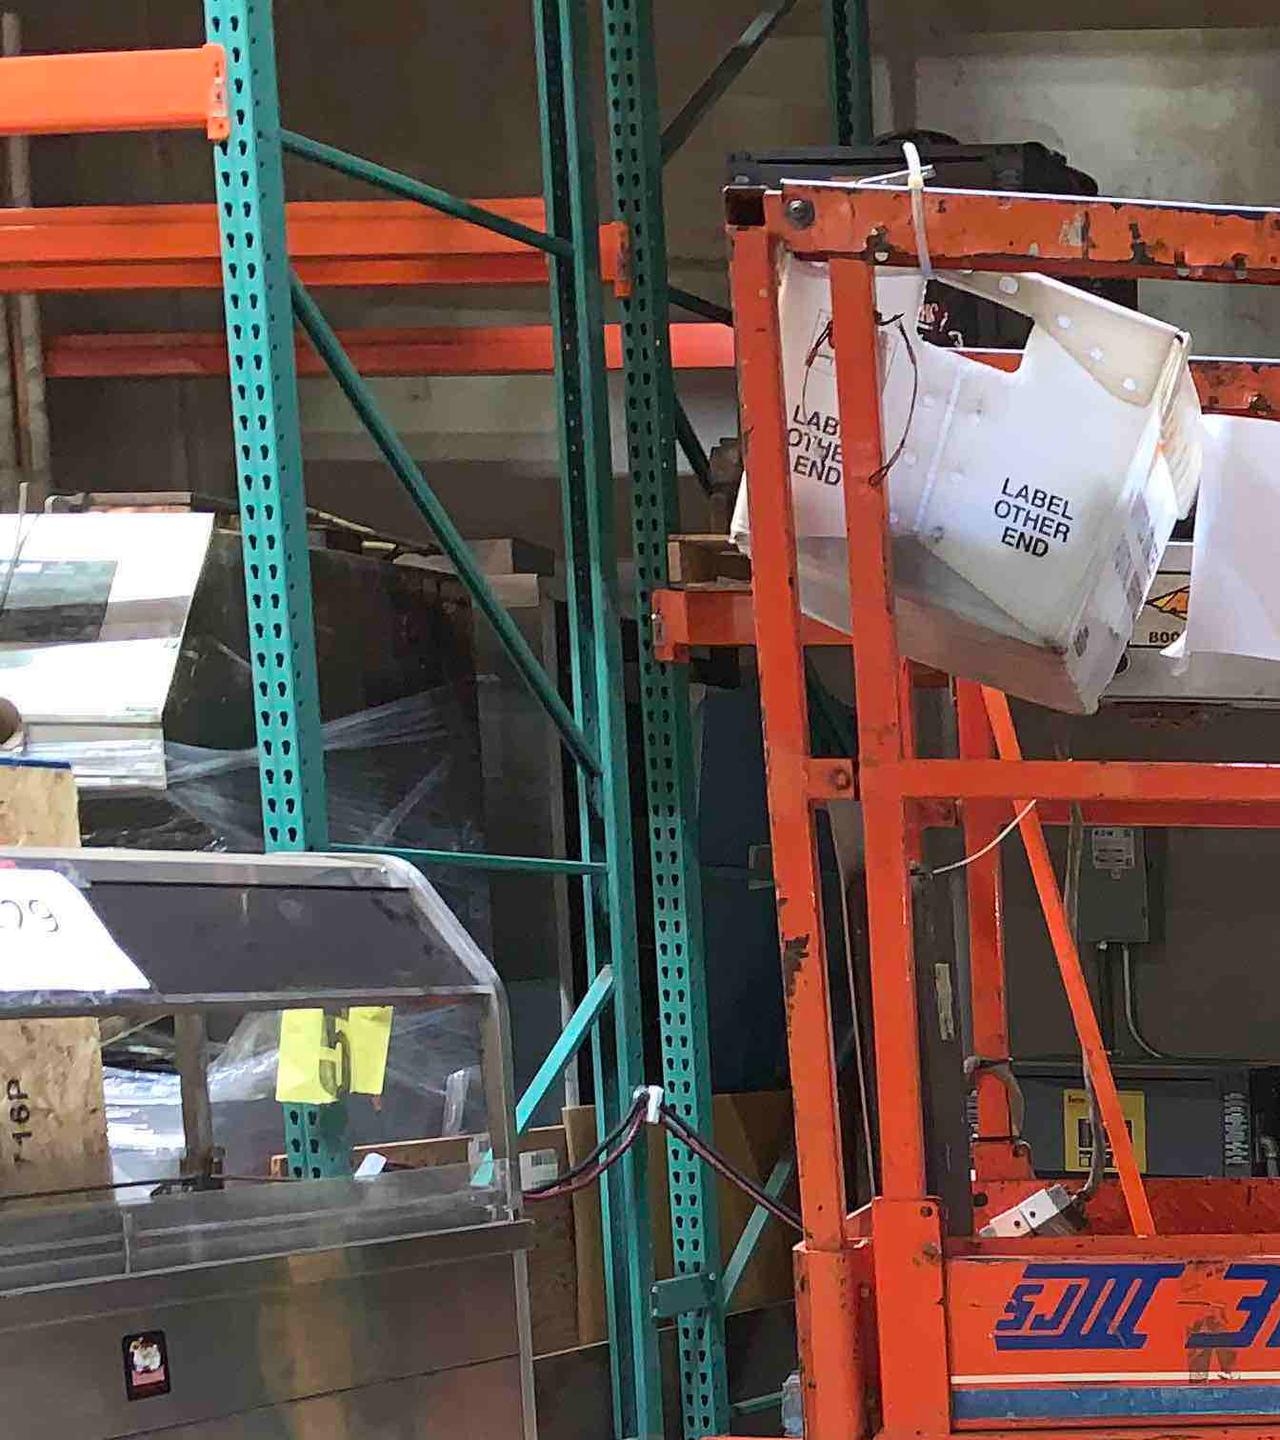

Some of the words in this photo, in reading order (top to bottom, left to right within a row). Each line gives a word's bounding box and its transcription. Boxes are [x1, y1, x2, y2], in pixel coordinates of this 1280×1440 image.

[792, 404, 840, 436] LAB
[787, 427, 842, 465] OTHE
[793, 455, 841, 486] END
[1001, 477, 1074, 521] LABEL
[993, 500, 1072, 543] OTHER
[1001, 527, 1051, 559] END
